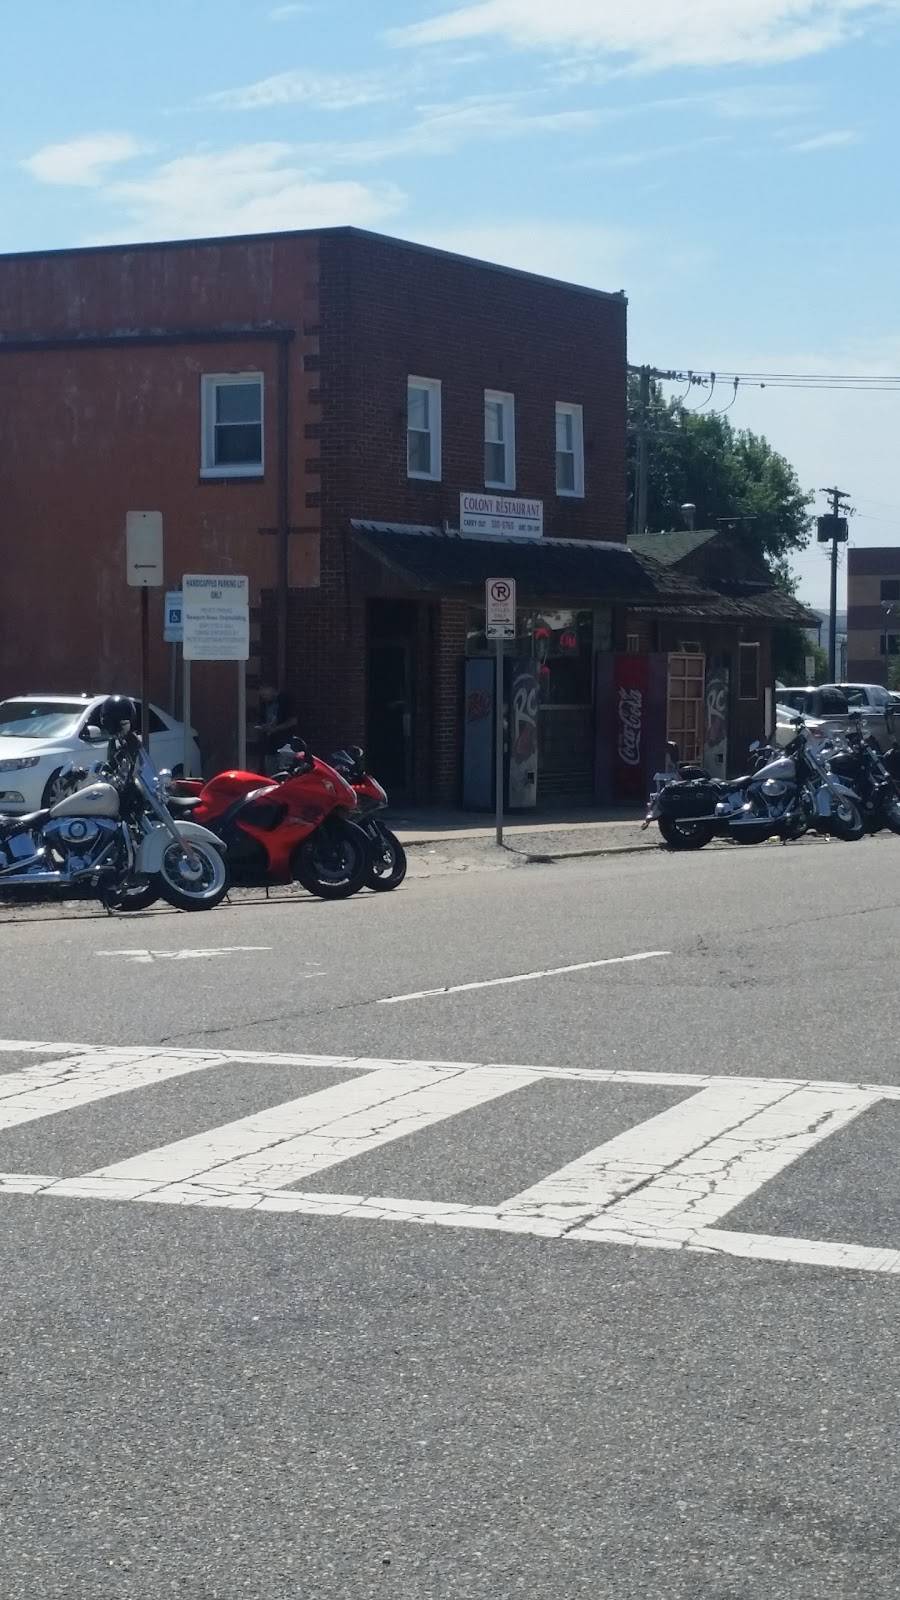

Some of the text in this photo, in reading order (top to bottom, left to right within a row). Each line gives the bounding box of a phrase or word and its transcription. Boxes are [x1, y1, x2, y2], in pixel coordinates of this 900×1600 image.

[464, 497, 540, 517] COLONY RESTAURANT
[464, 519, 477, 527] CARRY
[218, 579, 237, 588] PARKING
[513, 688, 538, 739] RC
[707, 689, 727, 729] RC
